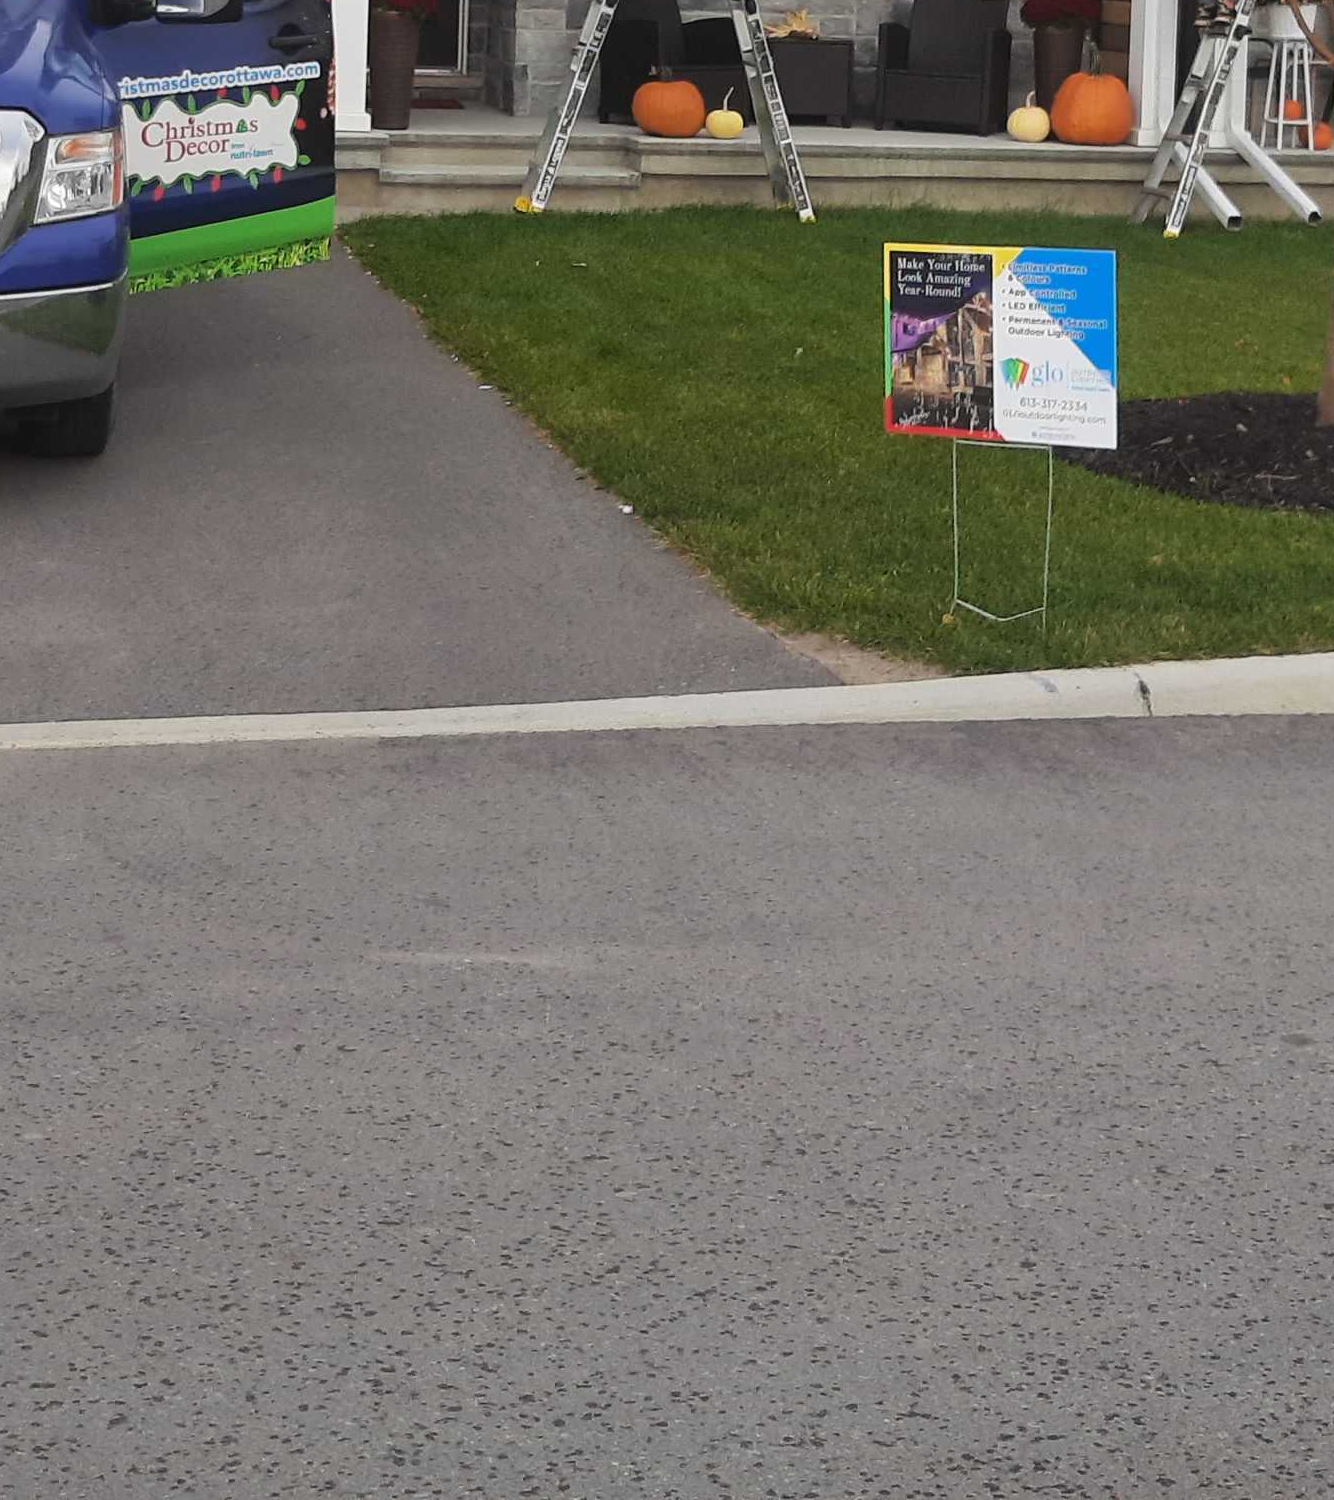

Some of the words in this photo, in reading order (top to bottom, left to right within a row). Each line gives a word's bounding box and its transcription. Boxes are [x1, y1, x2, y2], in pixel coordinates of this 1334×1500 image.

[141, 117, 258, 148] Christmas
[164, 138, 230, 163] Decor
[897, 257, 924, 269] Make
[927, 258, 953, 271] Your
[955, 260, 986, 272] Home
[1049, 264, 1086, 275] Patterns
[897, 270, 922, 283] Look
[926, 272, 971, 287] Amazing
[897, 283, 962, 298] Year-Round!
[1008, 289, 1027, 298] App
[1029, 289, 1076, 299] Controlled
[1008, 302, 1026, 310] LED
[1028, 303, 1066, 313] Efficient
[1008, 315, 1056, 326] Permanent
[1066, 319, 1107, 329] Seasonal
[1008, 326, 1045, 337] Outdoor
[1047, 329, 1084, 340] Lighting
[1031, 359, 1063, 387] glo
